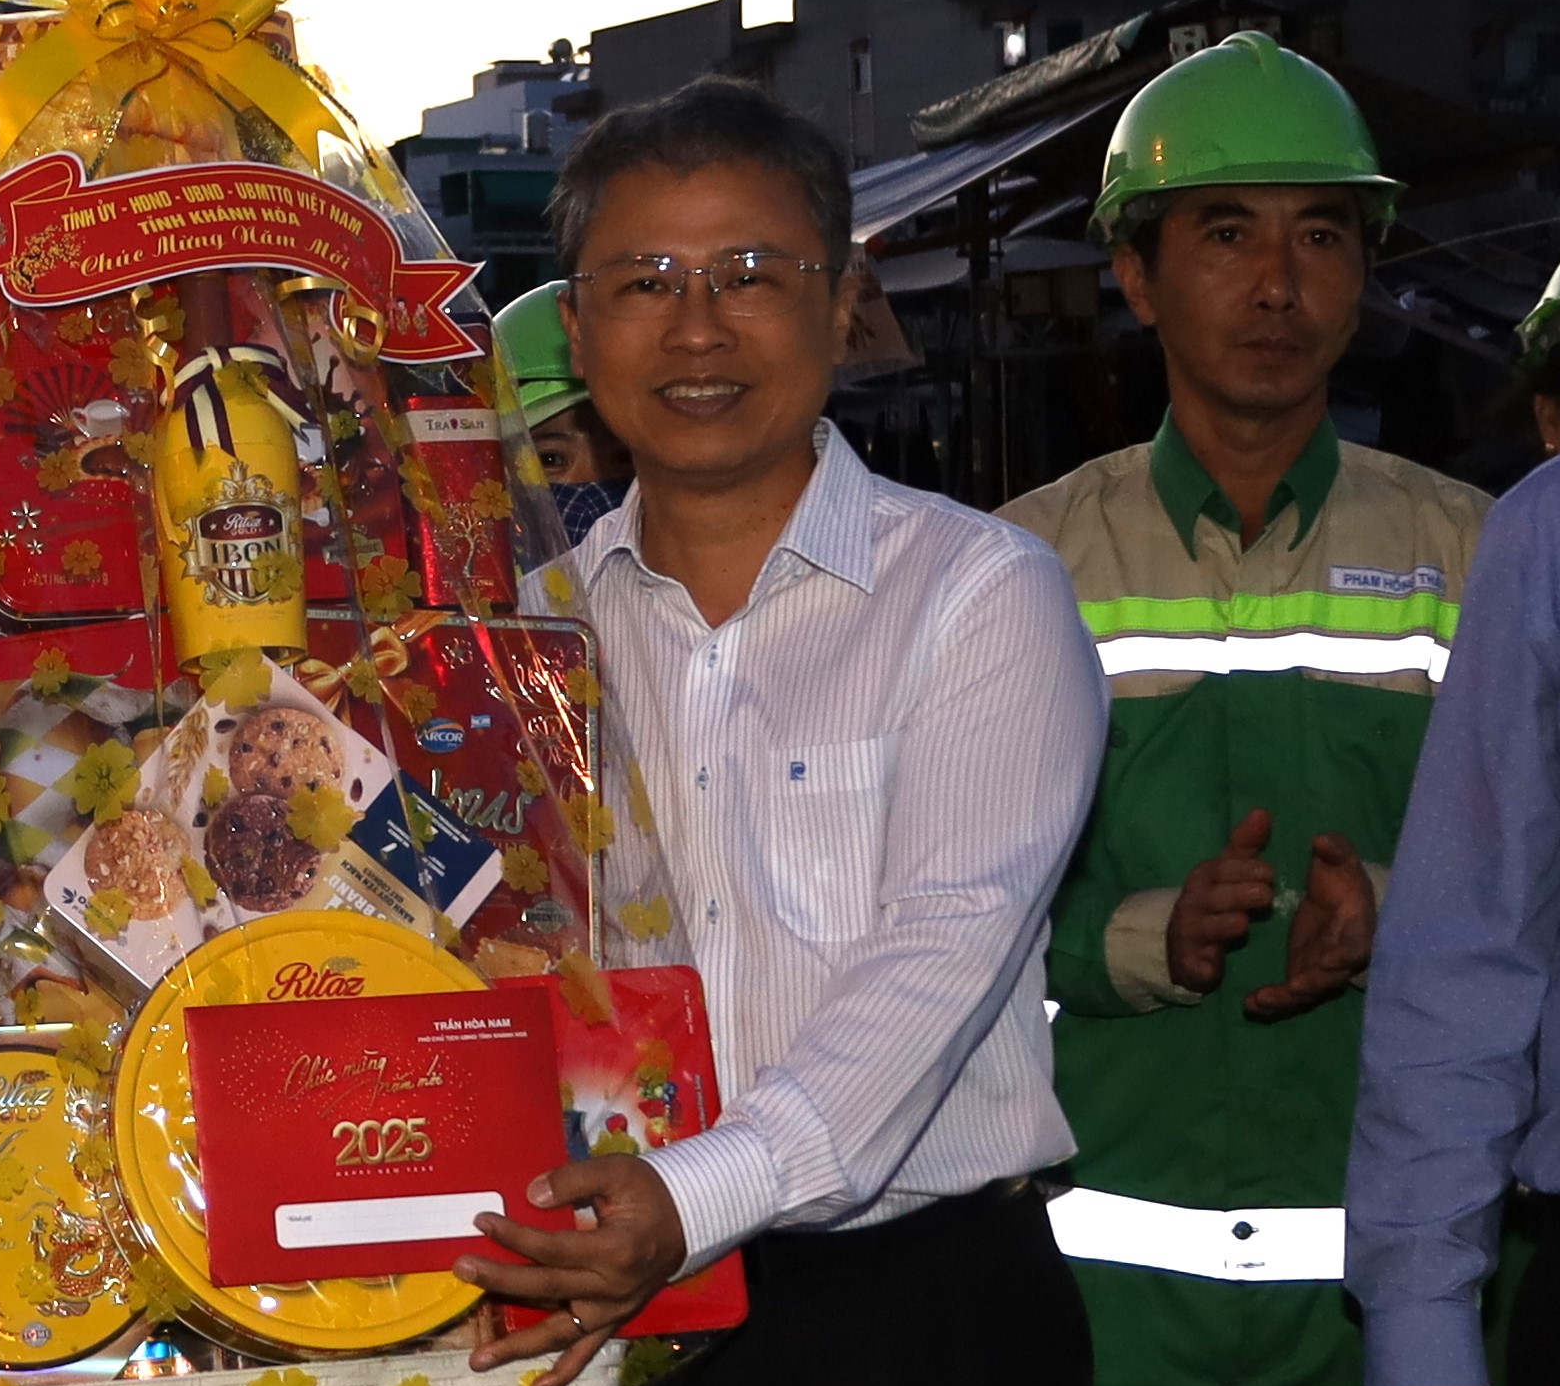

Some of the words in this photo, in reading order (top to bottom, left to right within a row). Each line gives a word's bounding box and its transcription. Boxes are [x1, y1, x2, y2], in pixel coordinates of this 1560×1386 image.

[181, 182, 225, 204] UBND
[234, 182, 293, 209] UBMTTQ
[296, 189, 327, 216] VIỆT
[329, 204, 364, 236] NAM
[187, 205, 257, 225] KHÁNH
[80, 246, 144, 276] Chúc
[231, 225, 297, 248] Năm
[267, 962, 366, 1000] Ritaz
[487, 1018, 512, 1028] NAM
[332, 1117, 433, 1166] 2025
